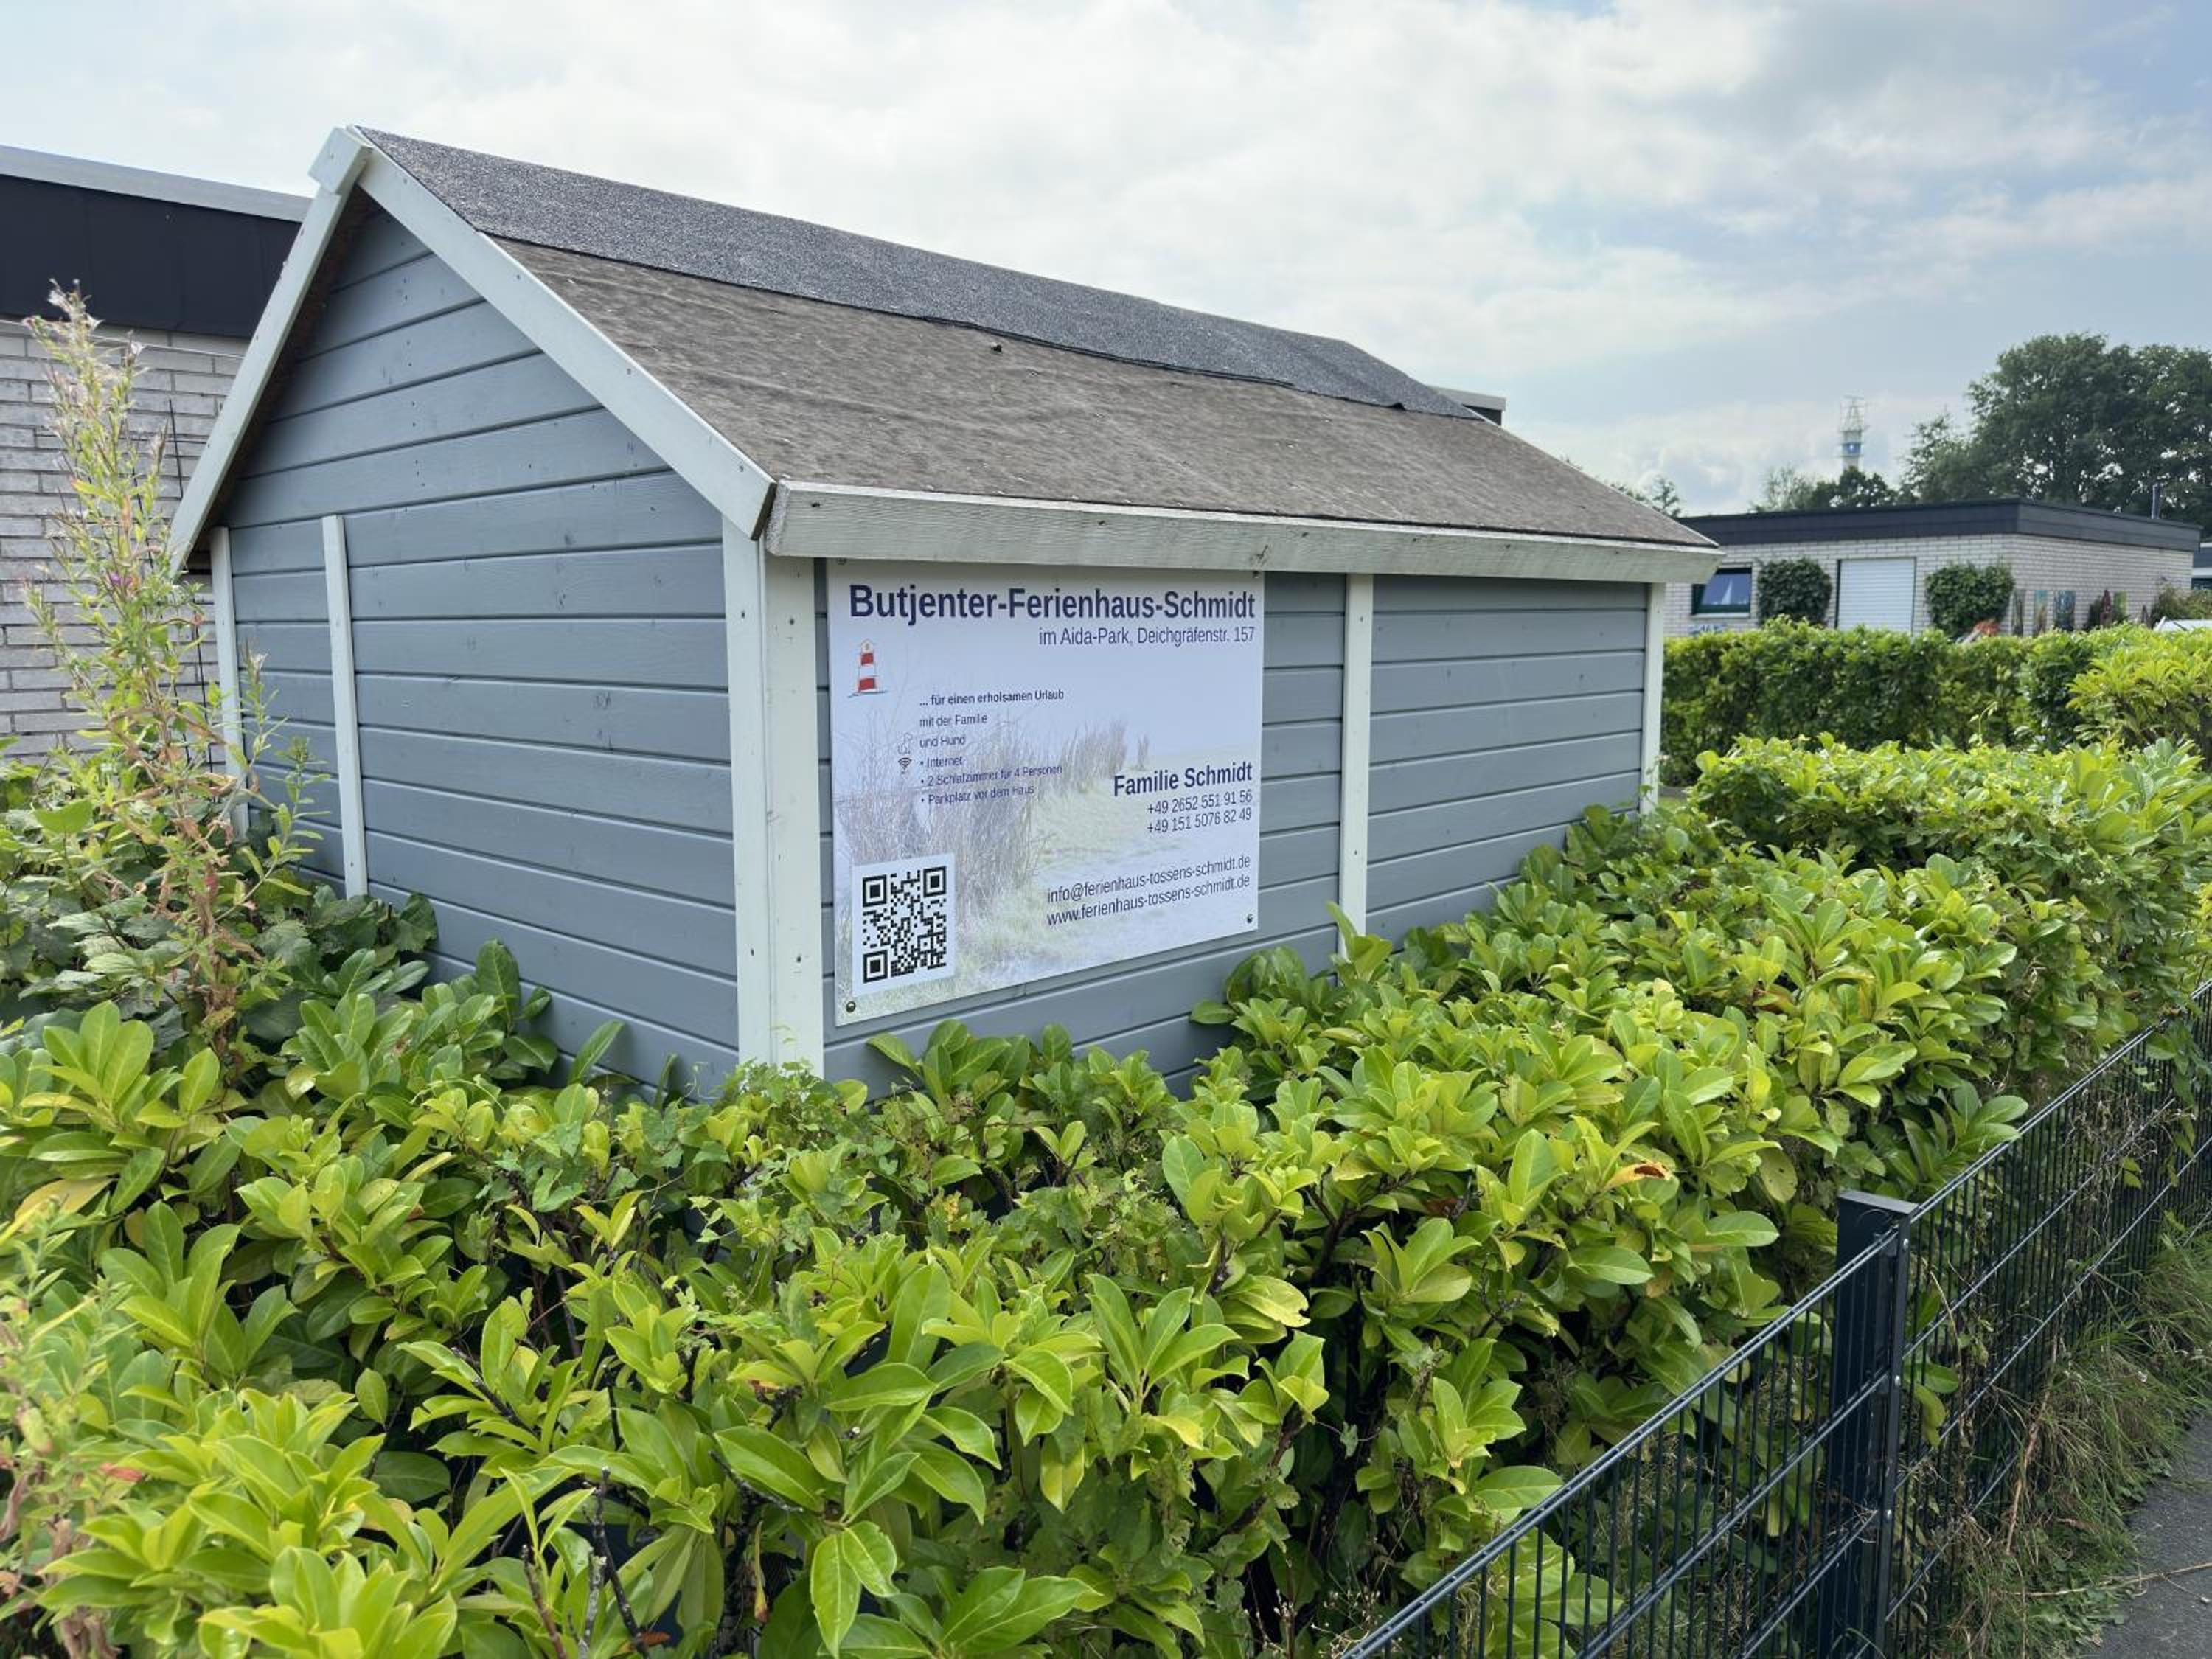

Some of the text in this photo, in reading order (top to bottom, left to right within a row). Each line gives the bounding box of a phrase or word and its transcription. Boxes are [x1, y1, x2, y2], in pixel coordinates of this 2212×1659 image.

[849, 583, 1256, 626] Butjenter-Ferienhaus-Schmidt
[1038, 627, 1057, 645] im
[1060, 627, 1133, 646] Aida-Park,
[1234, 626, 1255, 643] 157
[931, 694, 945, 706] für
[947, 692, 975, 705] einen
[977, 689, 1033, 704] erholsamen
[1034, 689, 1065, 701] Urlaub
[919, 713, 988, 728] mit der Familie
[919, 734, 967, 748] und Hund
[926, 756, 964, 768] Internet
[928, 775, 934, 786] 2
[1022, 764, 1063, 778] Personen
[1113, 760, 1253, 797] Familie Schmidt
[928, 790, 971, 806] Parkplatz
[990, 787, 1010, 799] dem
[1147, 788, 1253, 815] +49 2652 551 91 56
[1147, 806, 1252, 834] +49 151 5076 82 49
[1047, 854, 1251, 904] info@ferienhaus-tossens-schmidt.de
[1046, 874, 1251, 926] www.ferienhaus-tossens-schmidt.de
